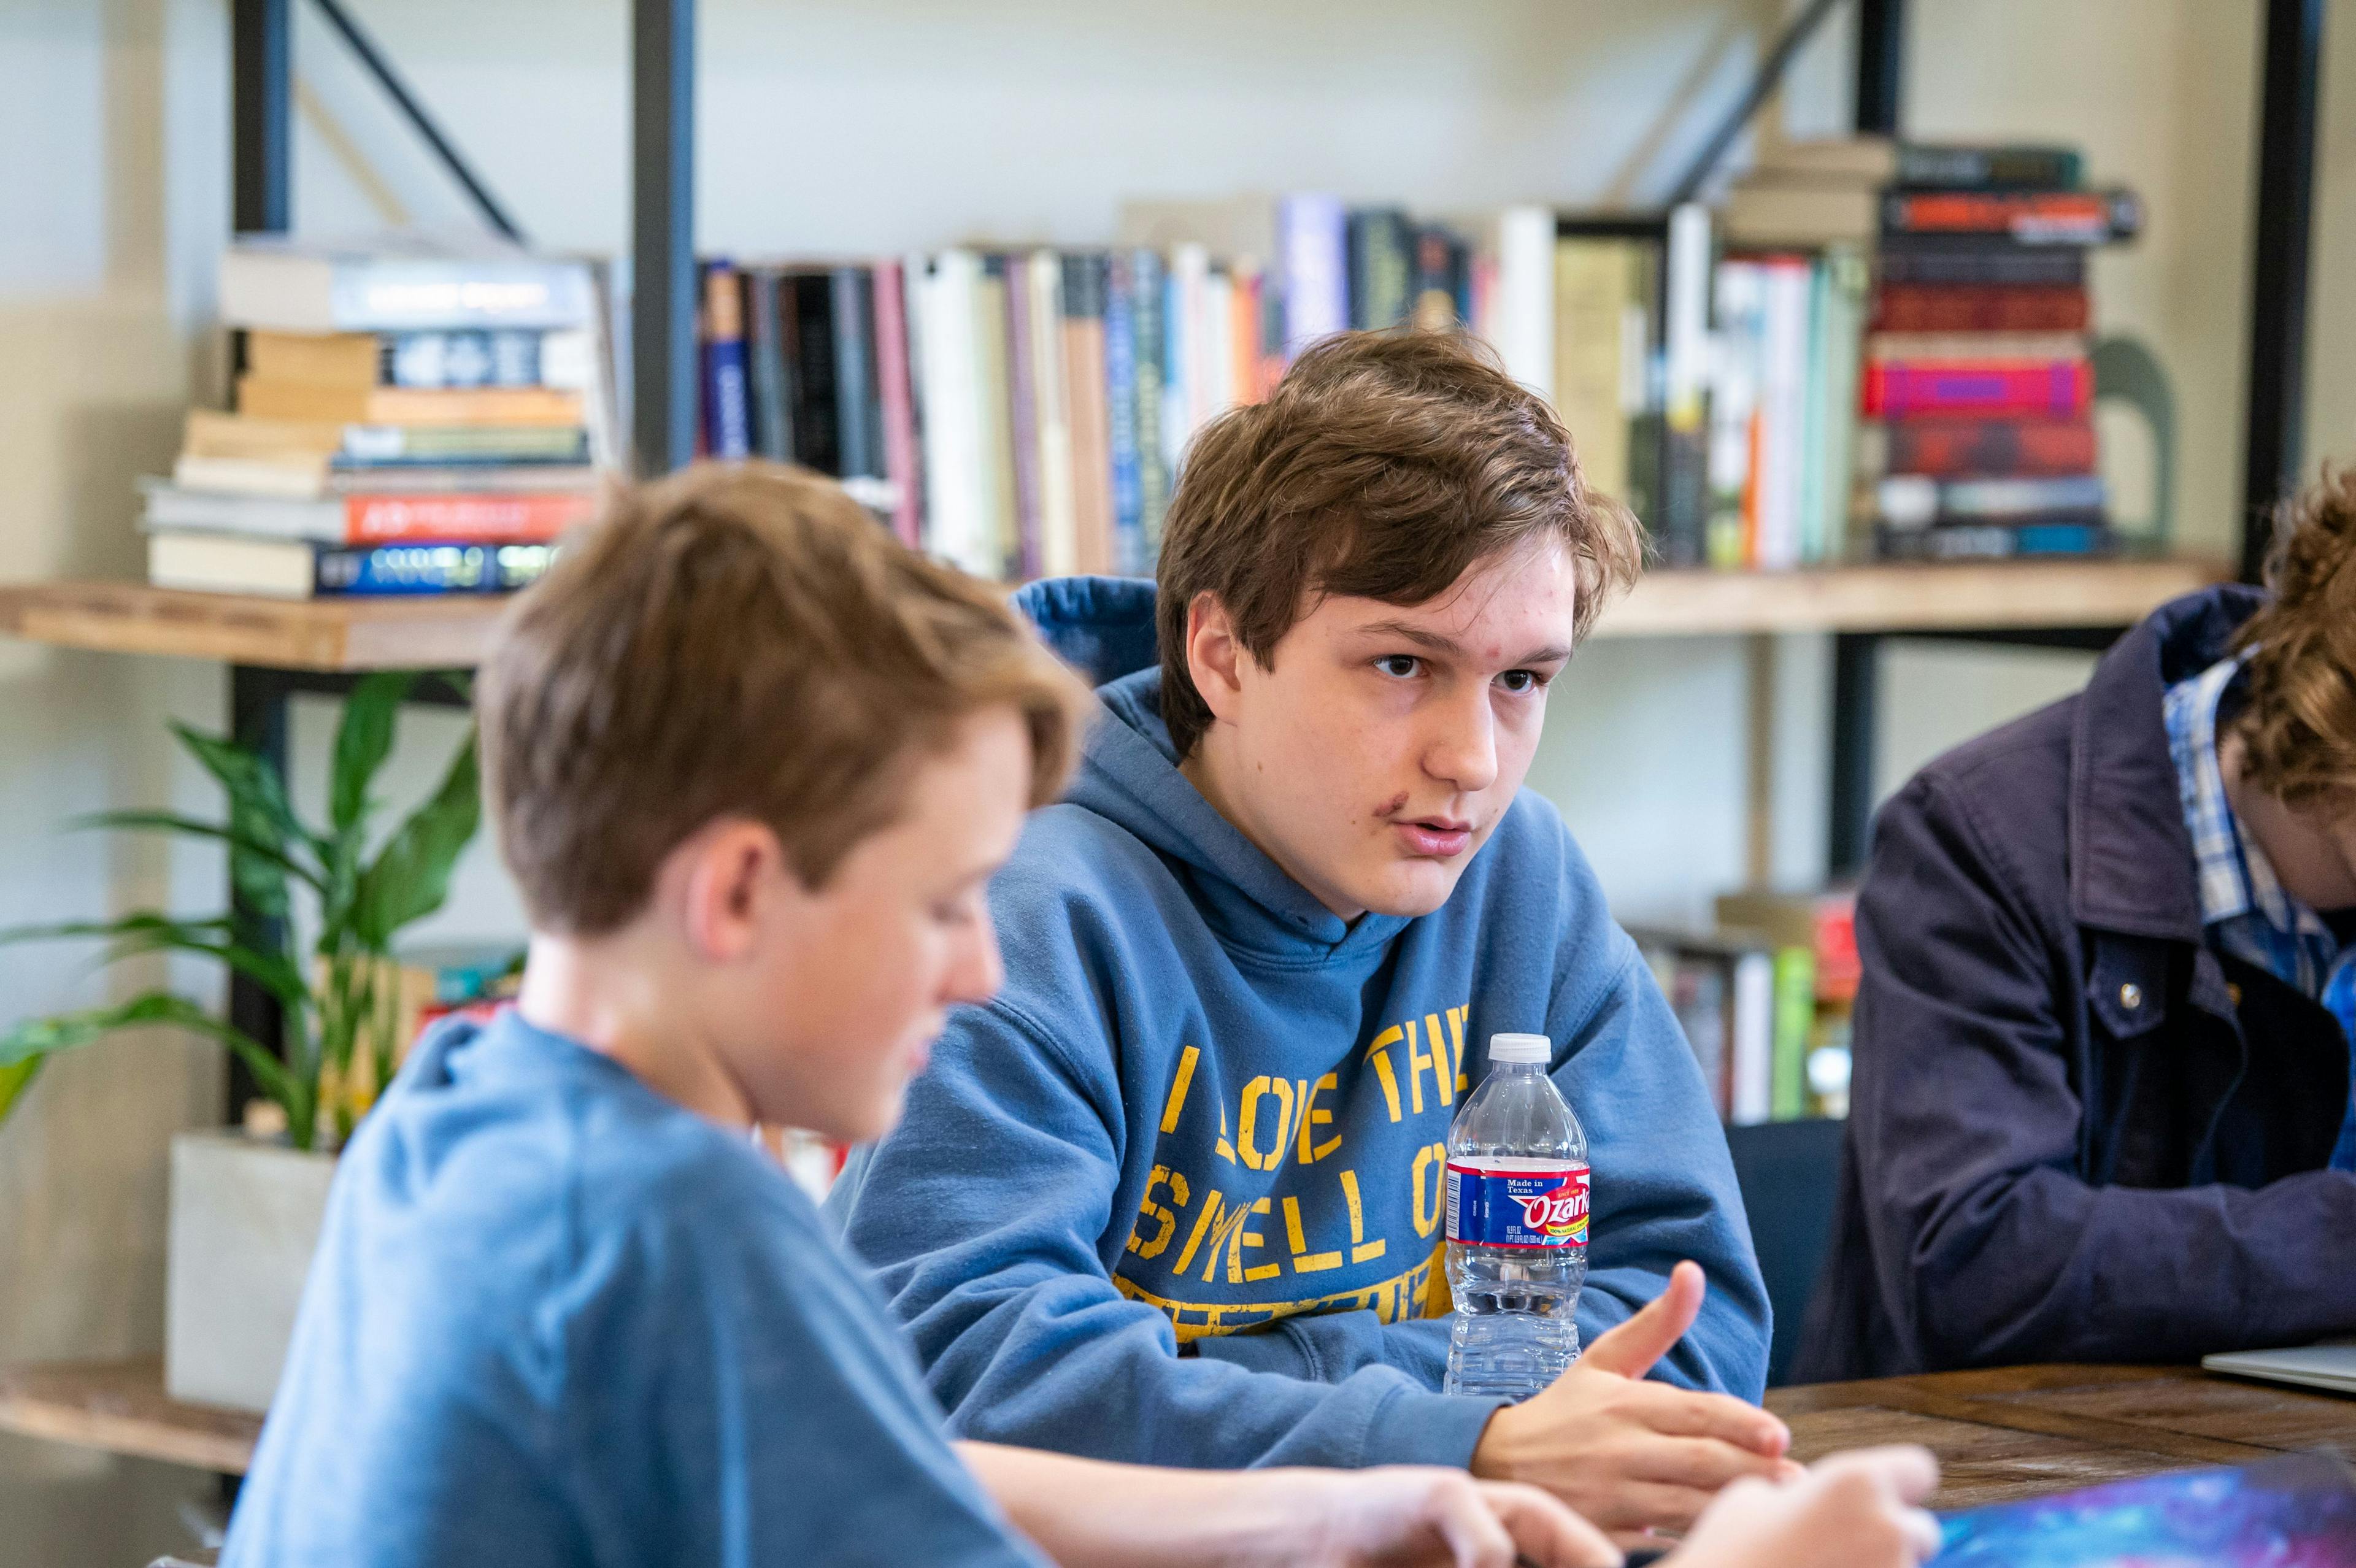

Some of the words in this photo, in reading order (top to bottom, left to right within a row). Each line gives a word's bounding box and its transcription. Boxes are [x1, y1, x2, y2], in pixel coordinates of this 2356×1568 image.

[1160, 1045, 1201, 1134] I
[1363, 1003, 1470, 1124] THE
[1126, 1164, 1386, 1283] SMELL
[1412, 1142, 1447, 1239] O
[1524, 1188, 1590, 1229] Ozark
